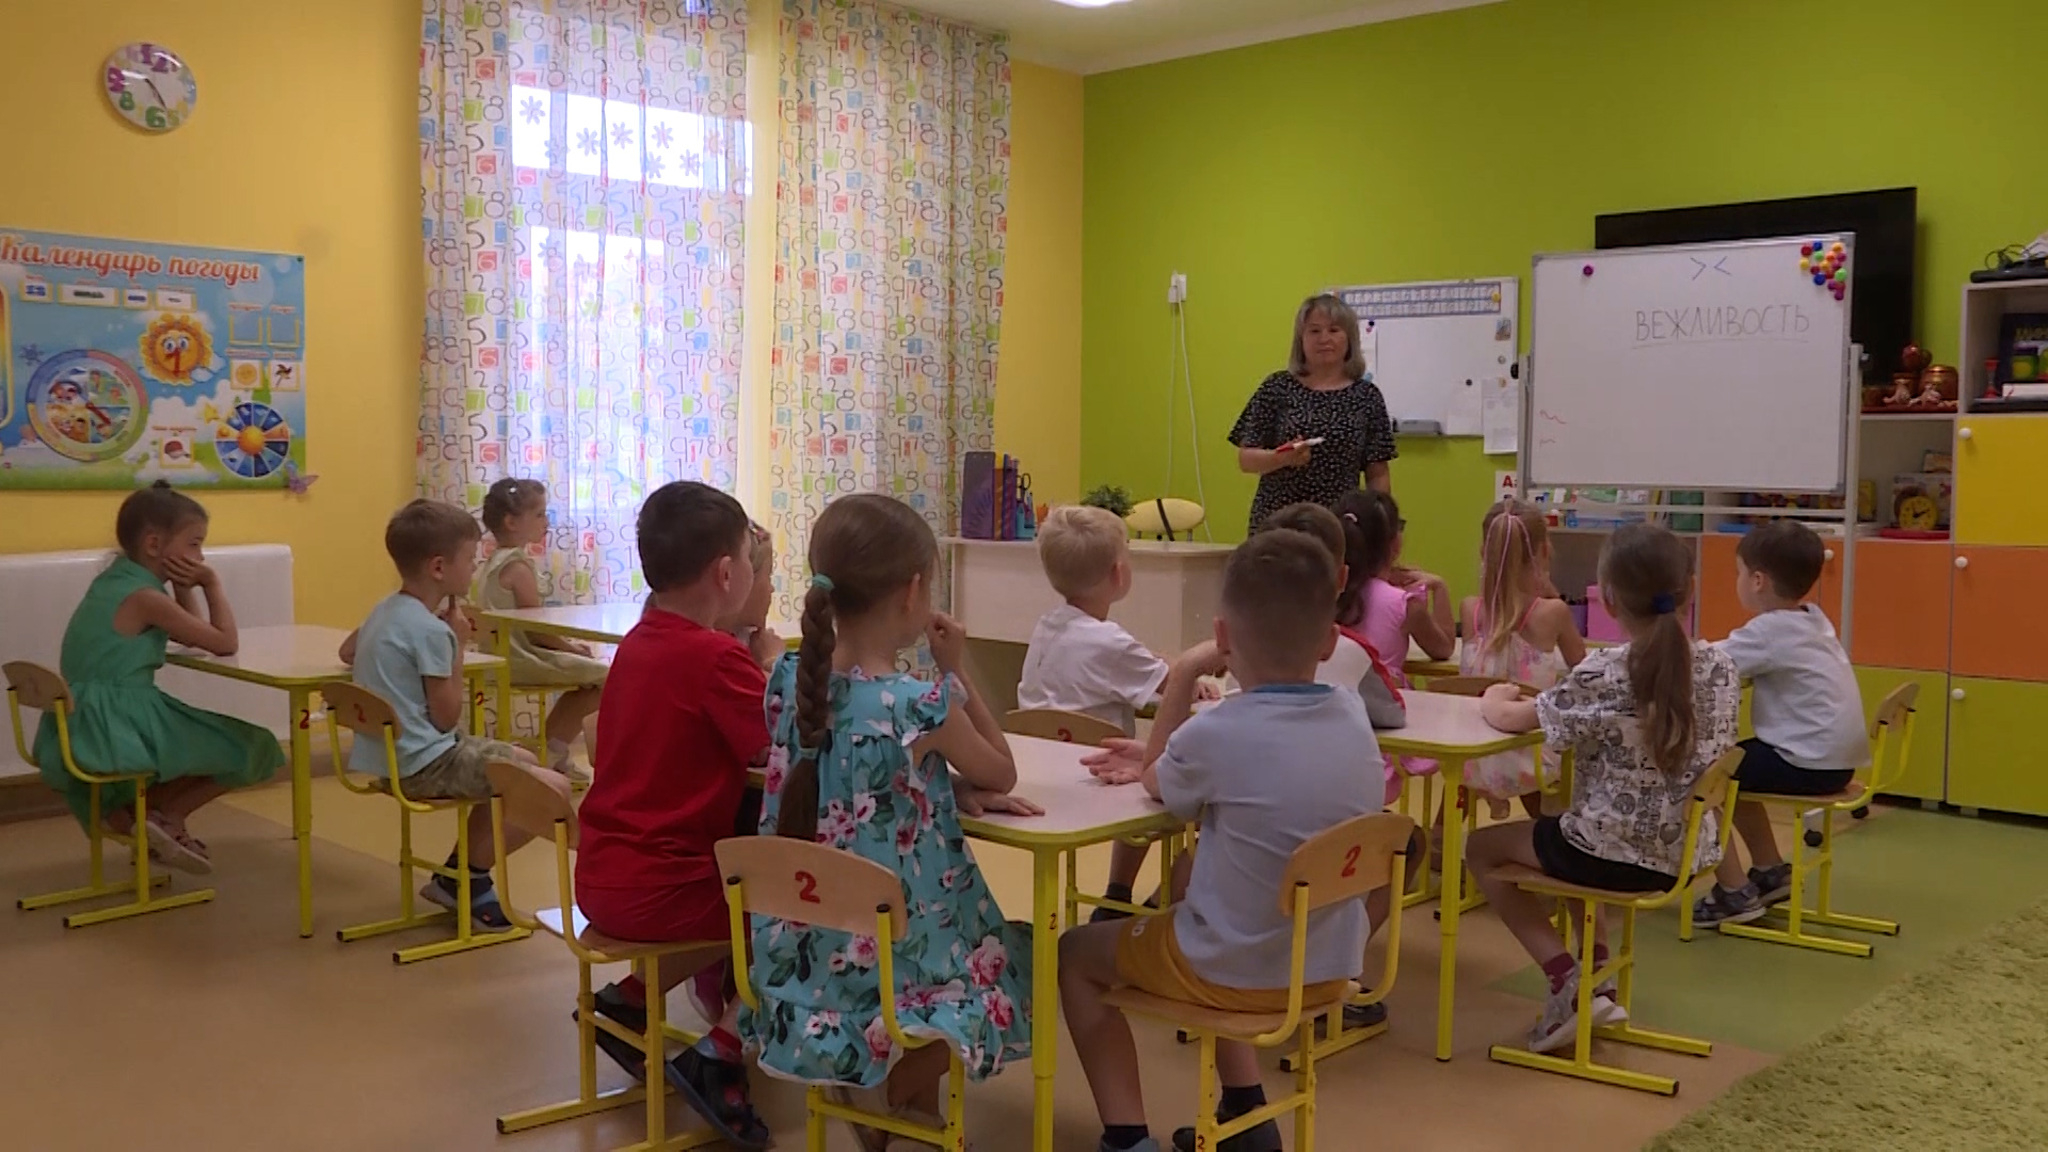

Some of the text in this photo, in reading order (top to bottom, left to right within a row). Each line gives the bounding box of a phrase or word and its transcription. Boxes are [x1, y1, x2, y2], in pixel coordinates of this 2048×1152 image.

[107, 67, 125, 92] 9
[119, 91, 134, 111] 8
[145, 105, 166, 128] 6
[1, 235, 259, 286] Календарь погоды
[1636, 303, 1810, 342] ВЕЖЛИВОСТЬ
[299, 708, 310, 730] 2
[352, 702, 369, 724] 2
[1340, 845, 1362, 879] 2
[794, 870, 821, 904] 2
[1048, 912, 1057, 930] 2
